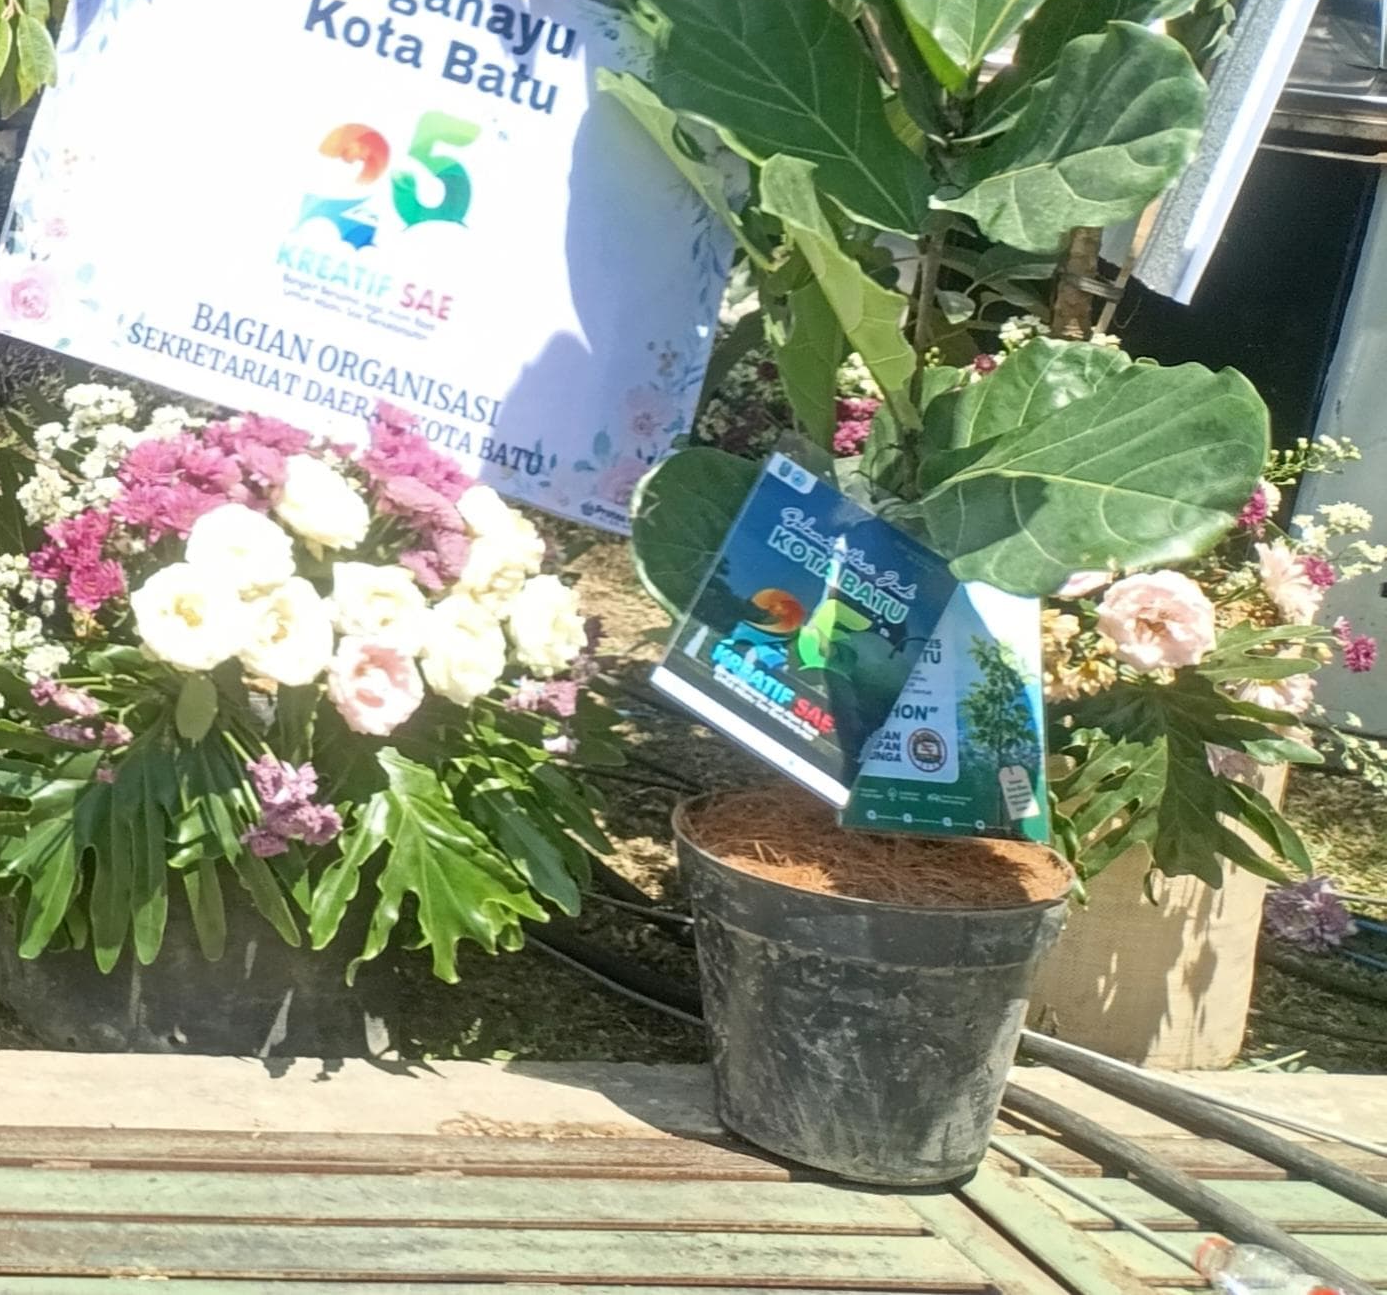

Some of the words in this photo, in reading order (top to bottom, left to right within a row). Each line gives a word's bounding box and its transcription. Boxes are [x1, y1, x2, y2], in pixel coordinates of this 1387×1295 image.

[441, 40, 558, 114] Batu
[289, 110, 482, 252] 25
[277, 241, 393, 297] KREATIF
[399, 282, 454, 322] SAE
[126, 322, 302, 396] SEKRETARIAT
[303, 378, 383, 424] DAERA
[478, 436, 545, 476] BATU
[191, 302, 314, 365] BAGIAN
[317, 344, 504, 427] ORGANISASI
[839, 568, 909, 624] BATU
[711, 643, 796, 704] KREATIF
[793, 697, 836, 734] SAE
